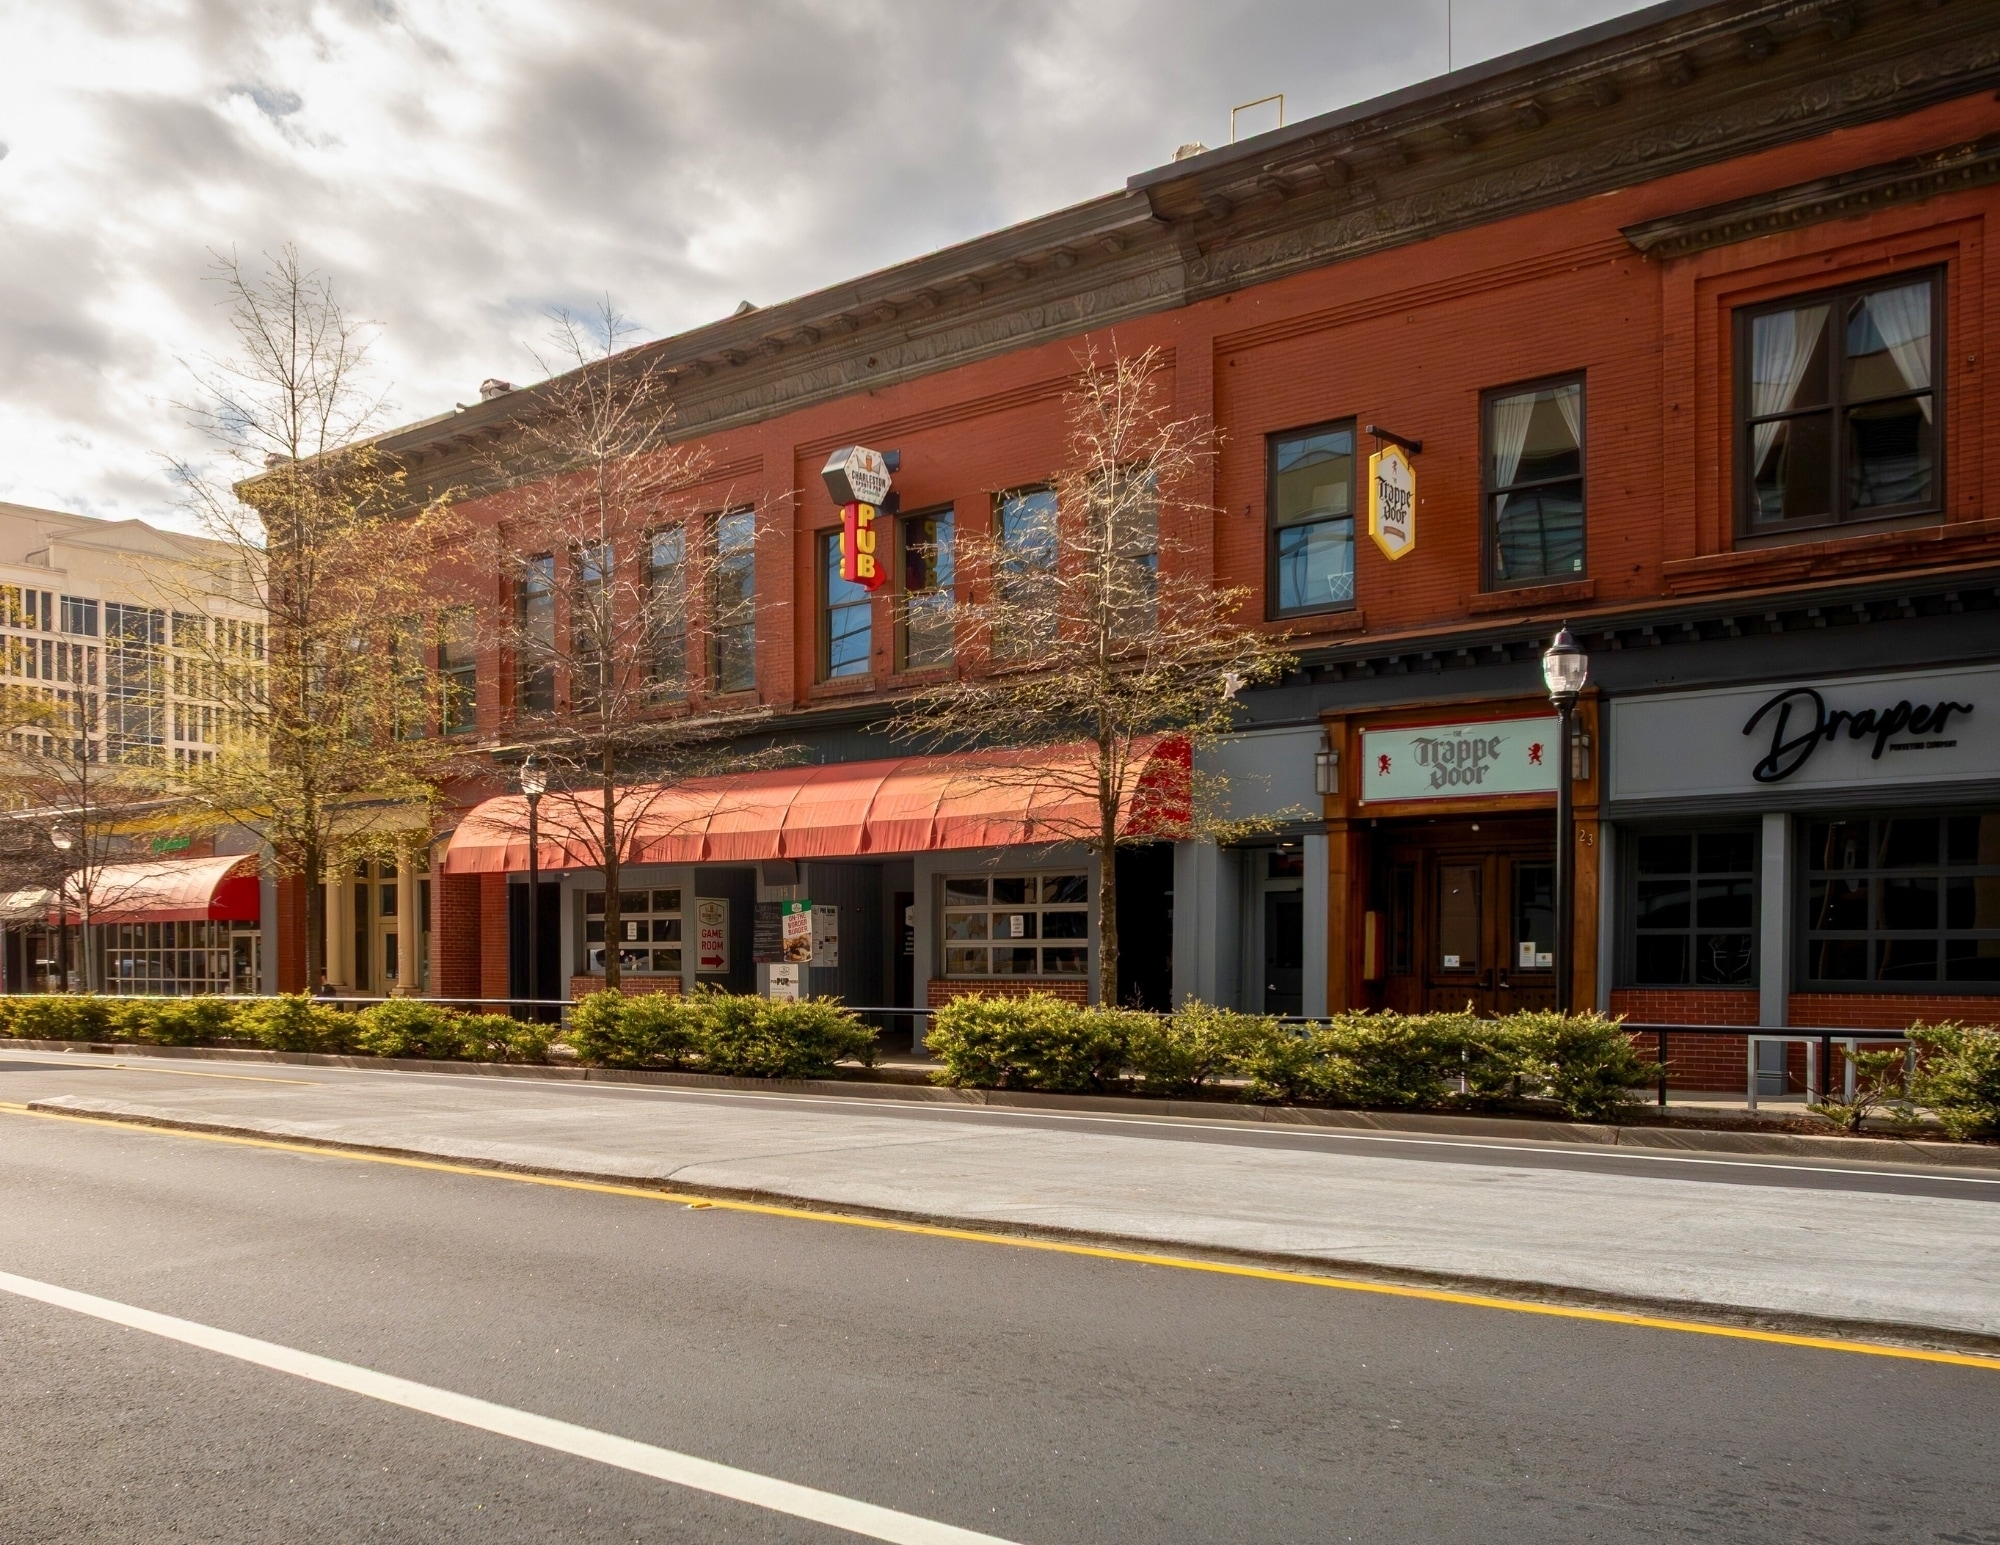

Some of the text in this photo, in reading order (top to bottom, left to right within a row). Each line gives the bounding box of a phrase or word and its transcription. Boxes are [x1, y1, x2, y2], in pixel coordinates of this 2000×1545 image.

[851, 470, 886, 488] CHARLESTON
[1375, 476, 1414, 510] Trappe
[1381, 500, 1407, 524] Door
[857, 503, 876, 578] PUB
[1742, 687, 1974, 783] Draper
[1408, 735, 1511, 768] Trappe
[1424, 764, 1490, 790] Door
[1579, 829, 1593, 846] 23
[701, 929, 723, 938] GAME
[701, 941, 723, 951] ROOM
